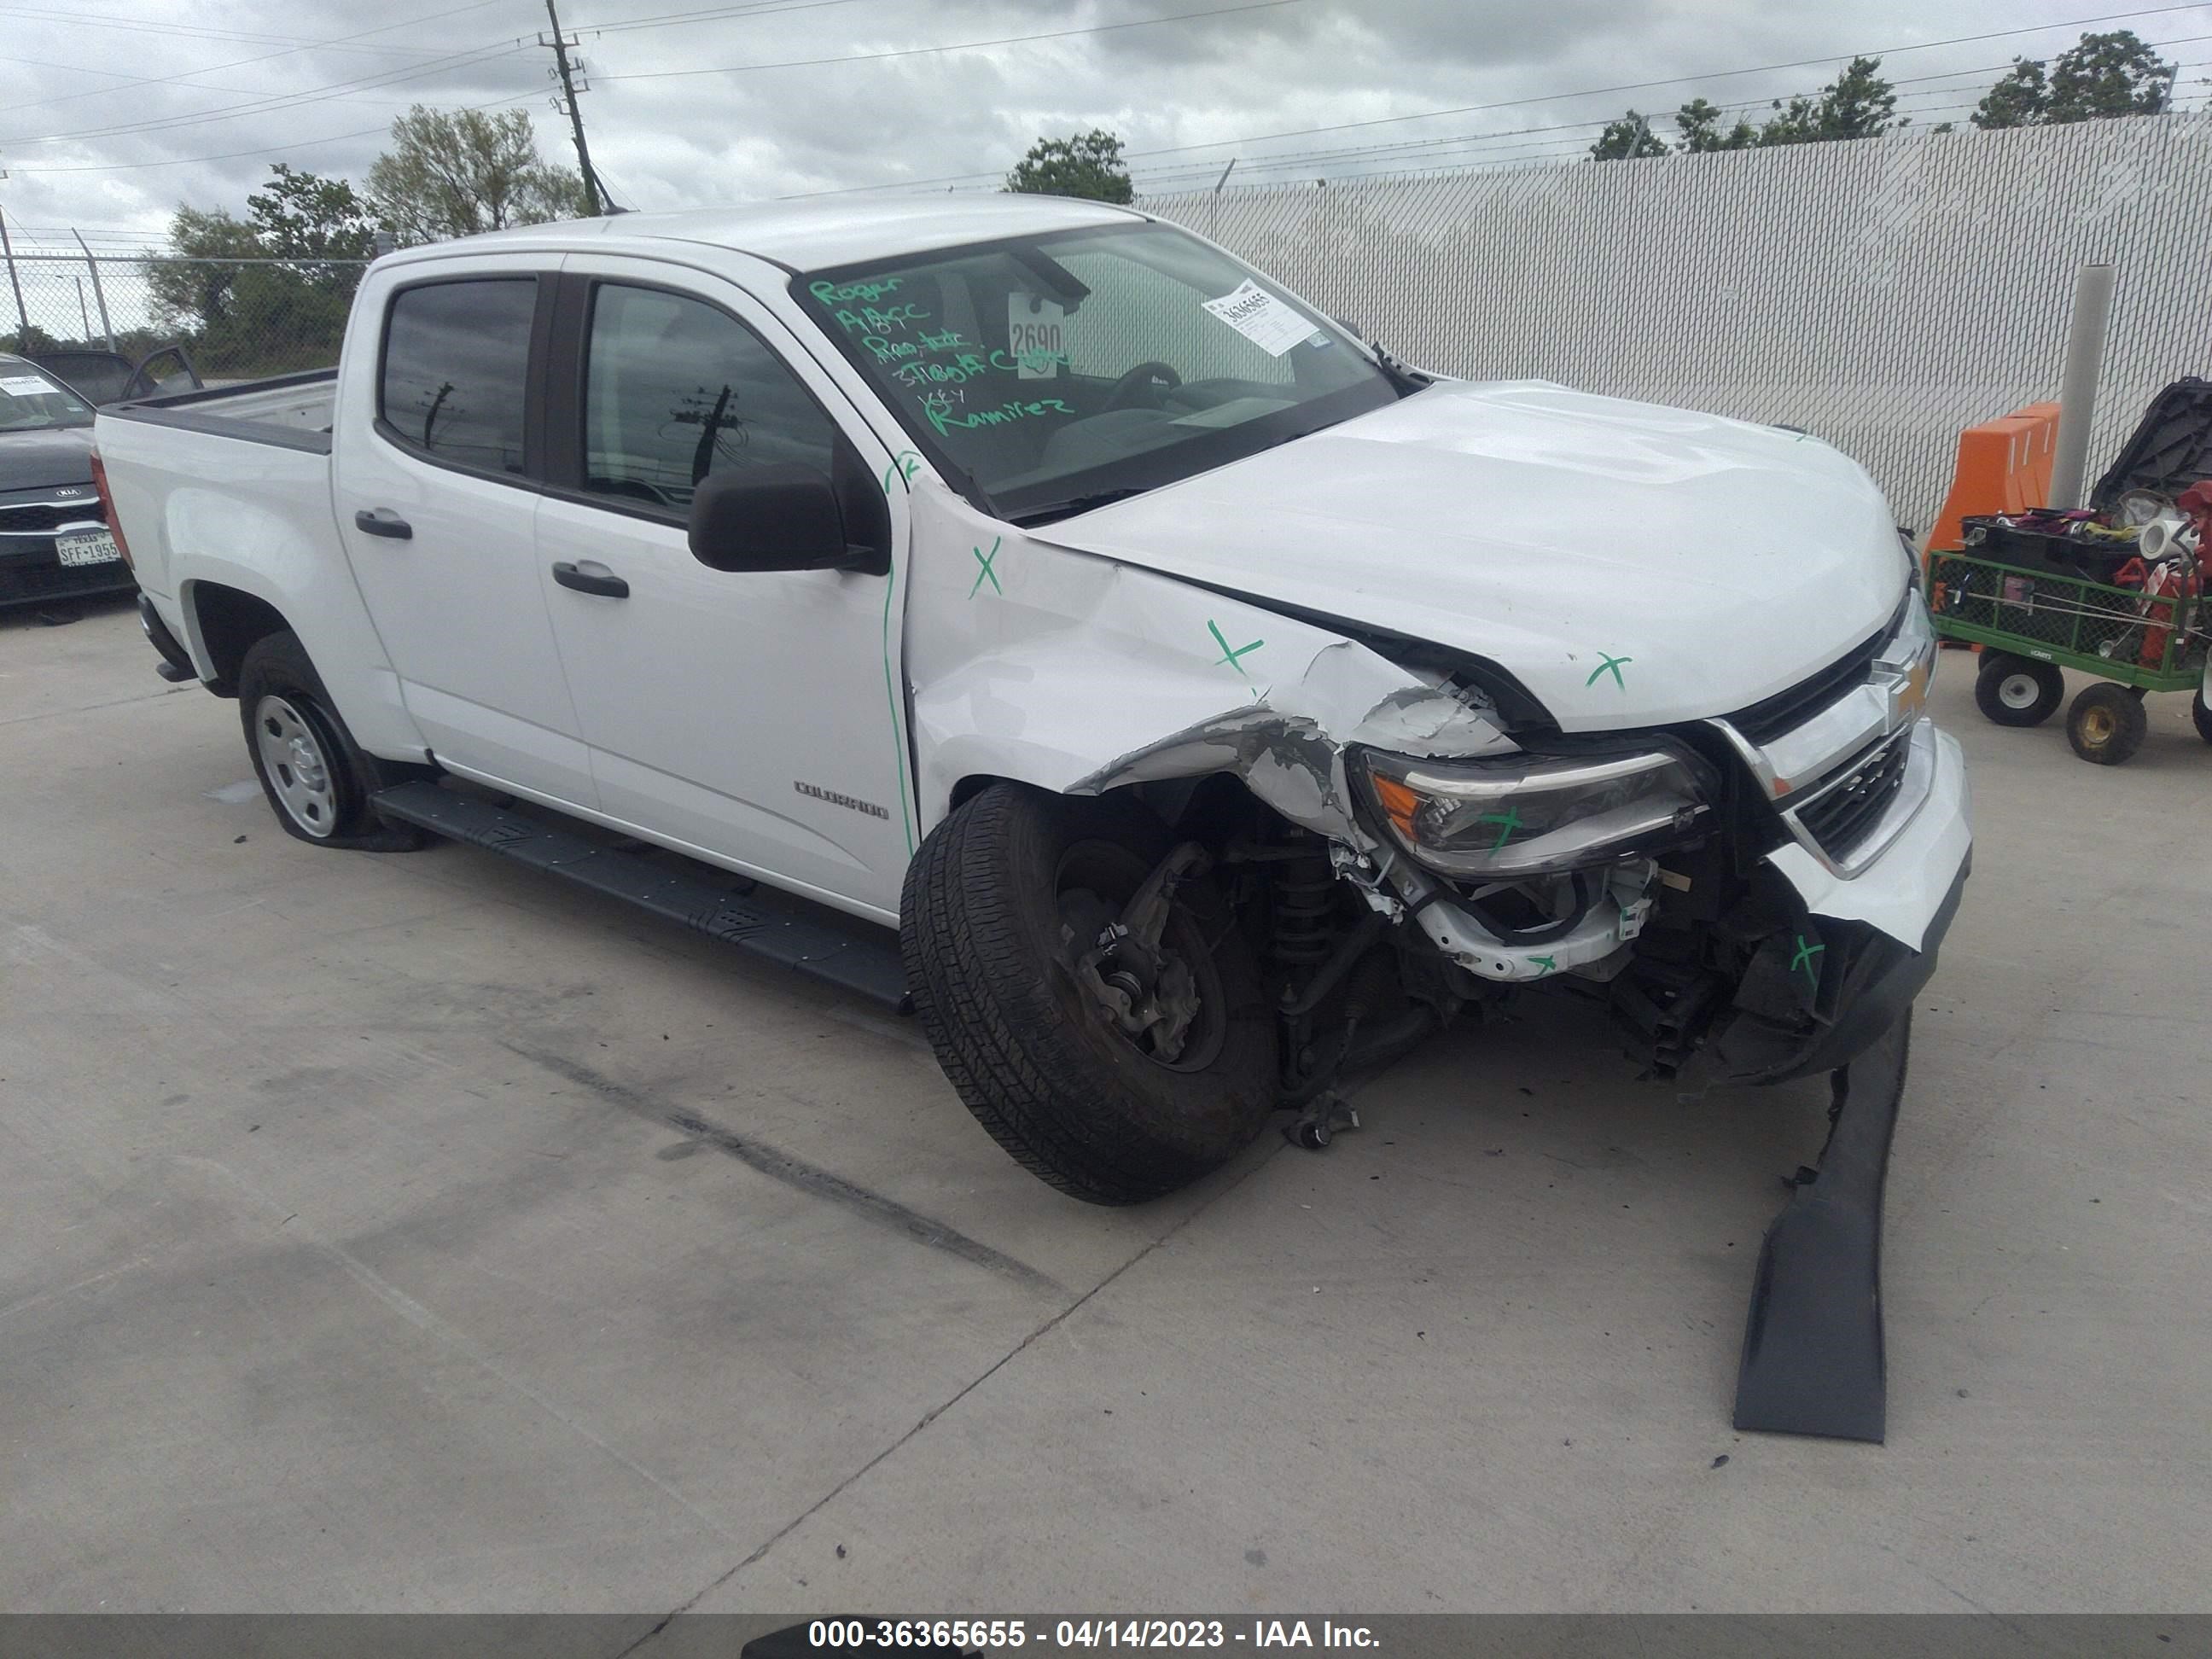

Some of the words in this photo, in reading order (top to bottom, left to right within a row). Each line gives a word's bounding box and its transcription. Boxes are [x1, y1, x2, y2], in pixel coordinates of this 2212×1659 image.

[1223, 293, 1271, 323] 36365655
[1013, 323, 1061, 356] 2690
[924, 399, 1075, 437] Ramirez
[794, 780, 889, 820] COLORADO
